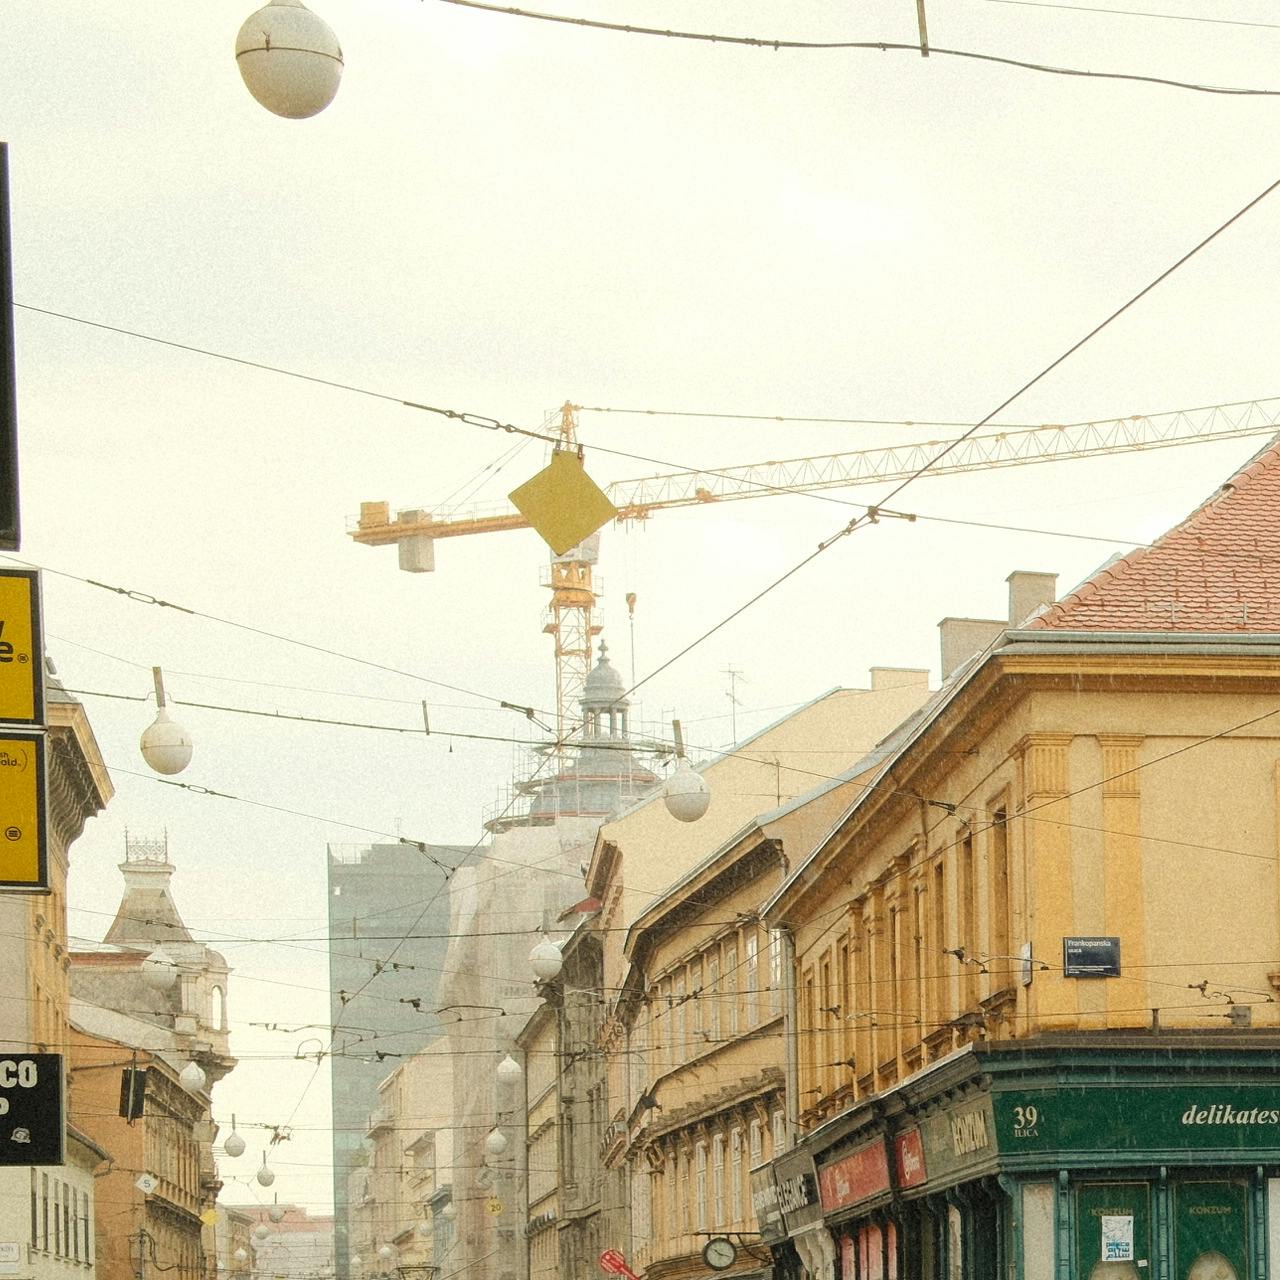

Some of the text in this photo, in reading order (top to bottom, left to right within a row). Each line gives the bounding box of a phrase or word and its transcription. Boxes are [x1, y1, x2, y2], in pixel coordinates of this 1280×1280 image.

[1014, 1106, 1037, 1129] 39
[1014, 1129, 1038, 1137] ILICA
[1189, 1206, 1232, 1215] KONZUM
